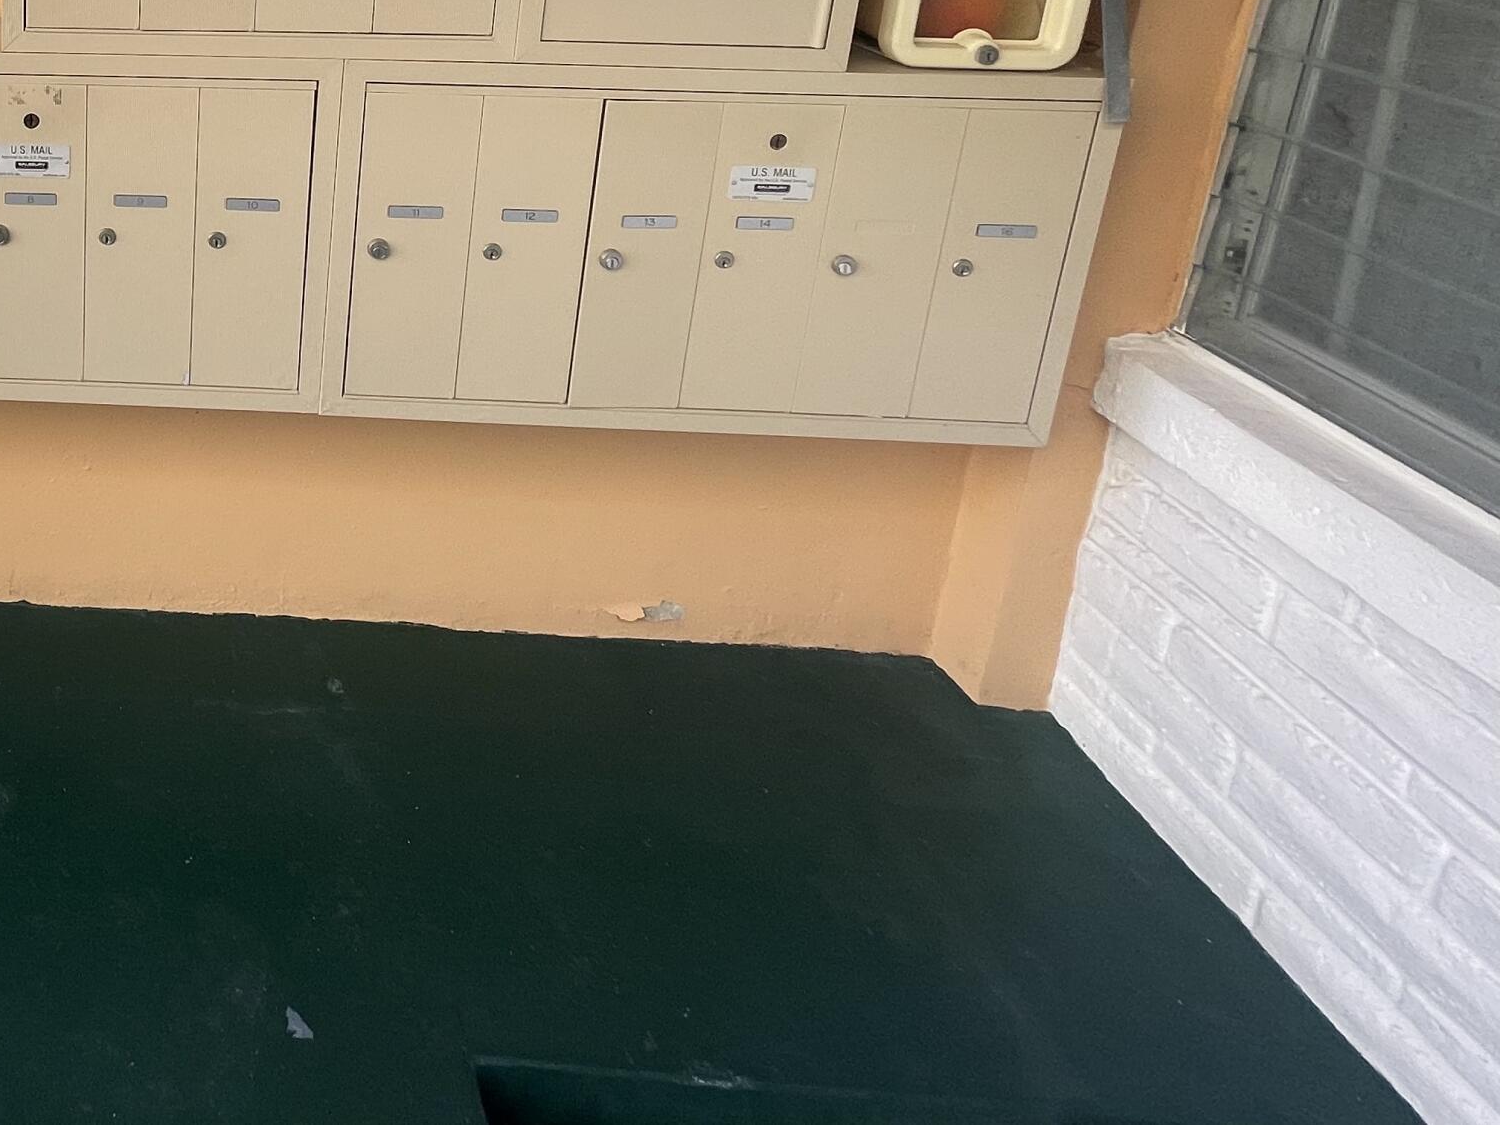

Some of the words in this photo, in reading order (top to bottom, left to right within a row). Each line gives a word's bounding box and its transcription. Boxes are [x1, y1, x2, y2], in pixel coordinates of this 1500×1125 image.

[30, 145, 53, 155] MAIL
[751, 167, 770, 177] U.S.
[772, 168, 797, 178] MAIL
[246, 201, 259, 210] 10
[525, 212, 536, 221] 12
[644, 217, 655, 226] 13
[759, 219, 771, 228] 14
